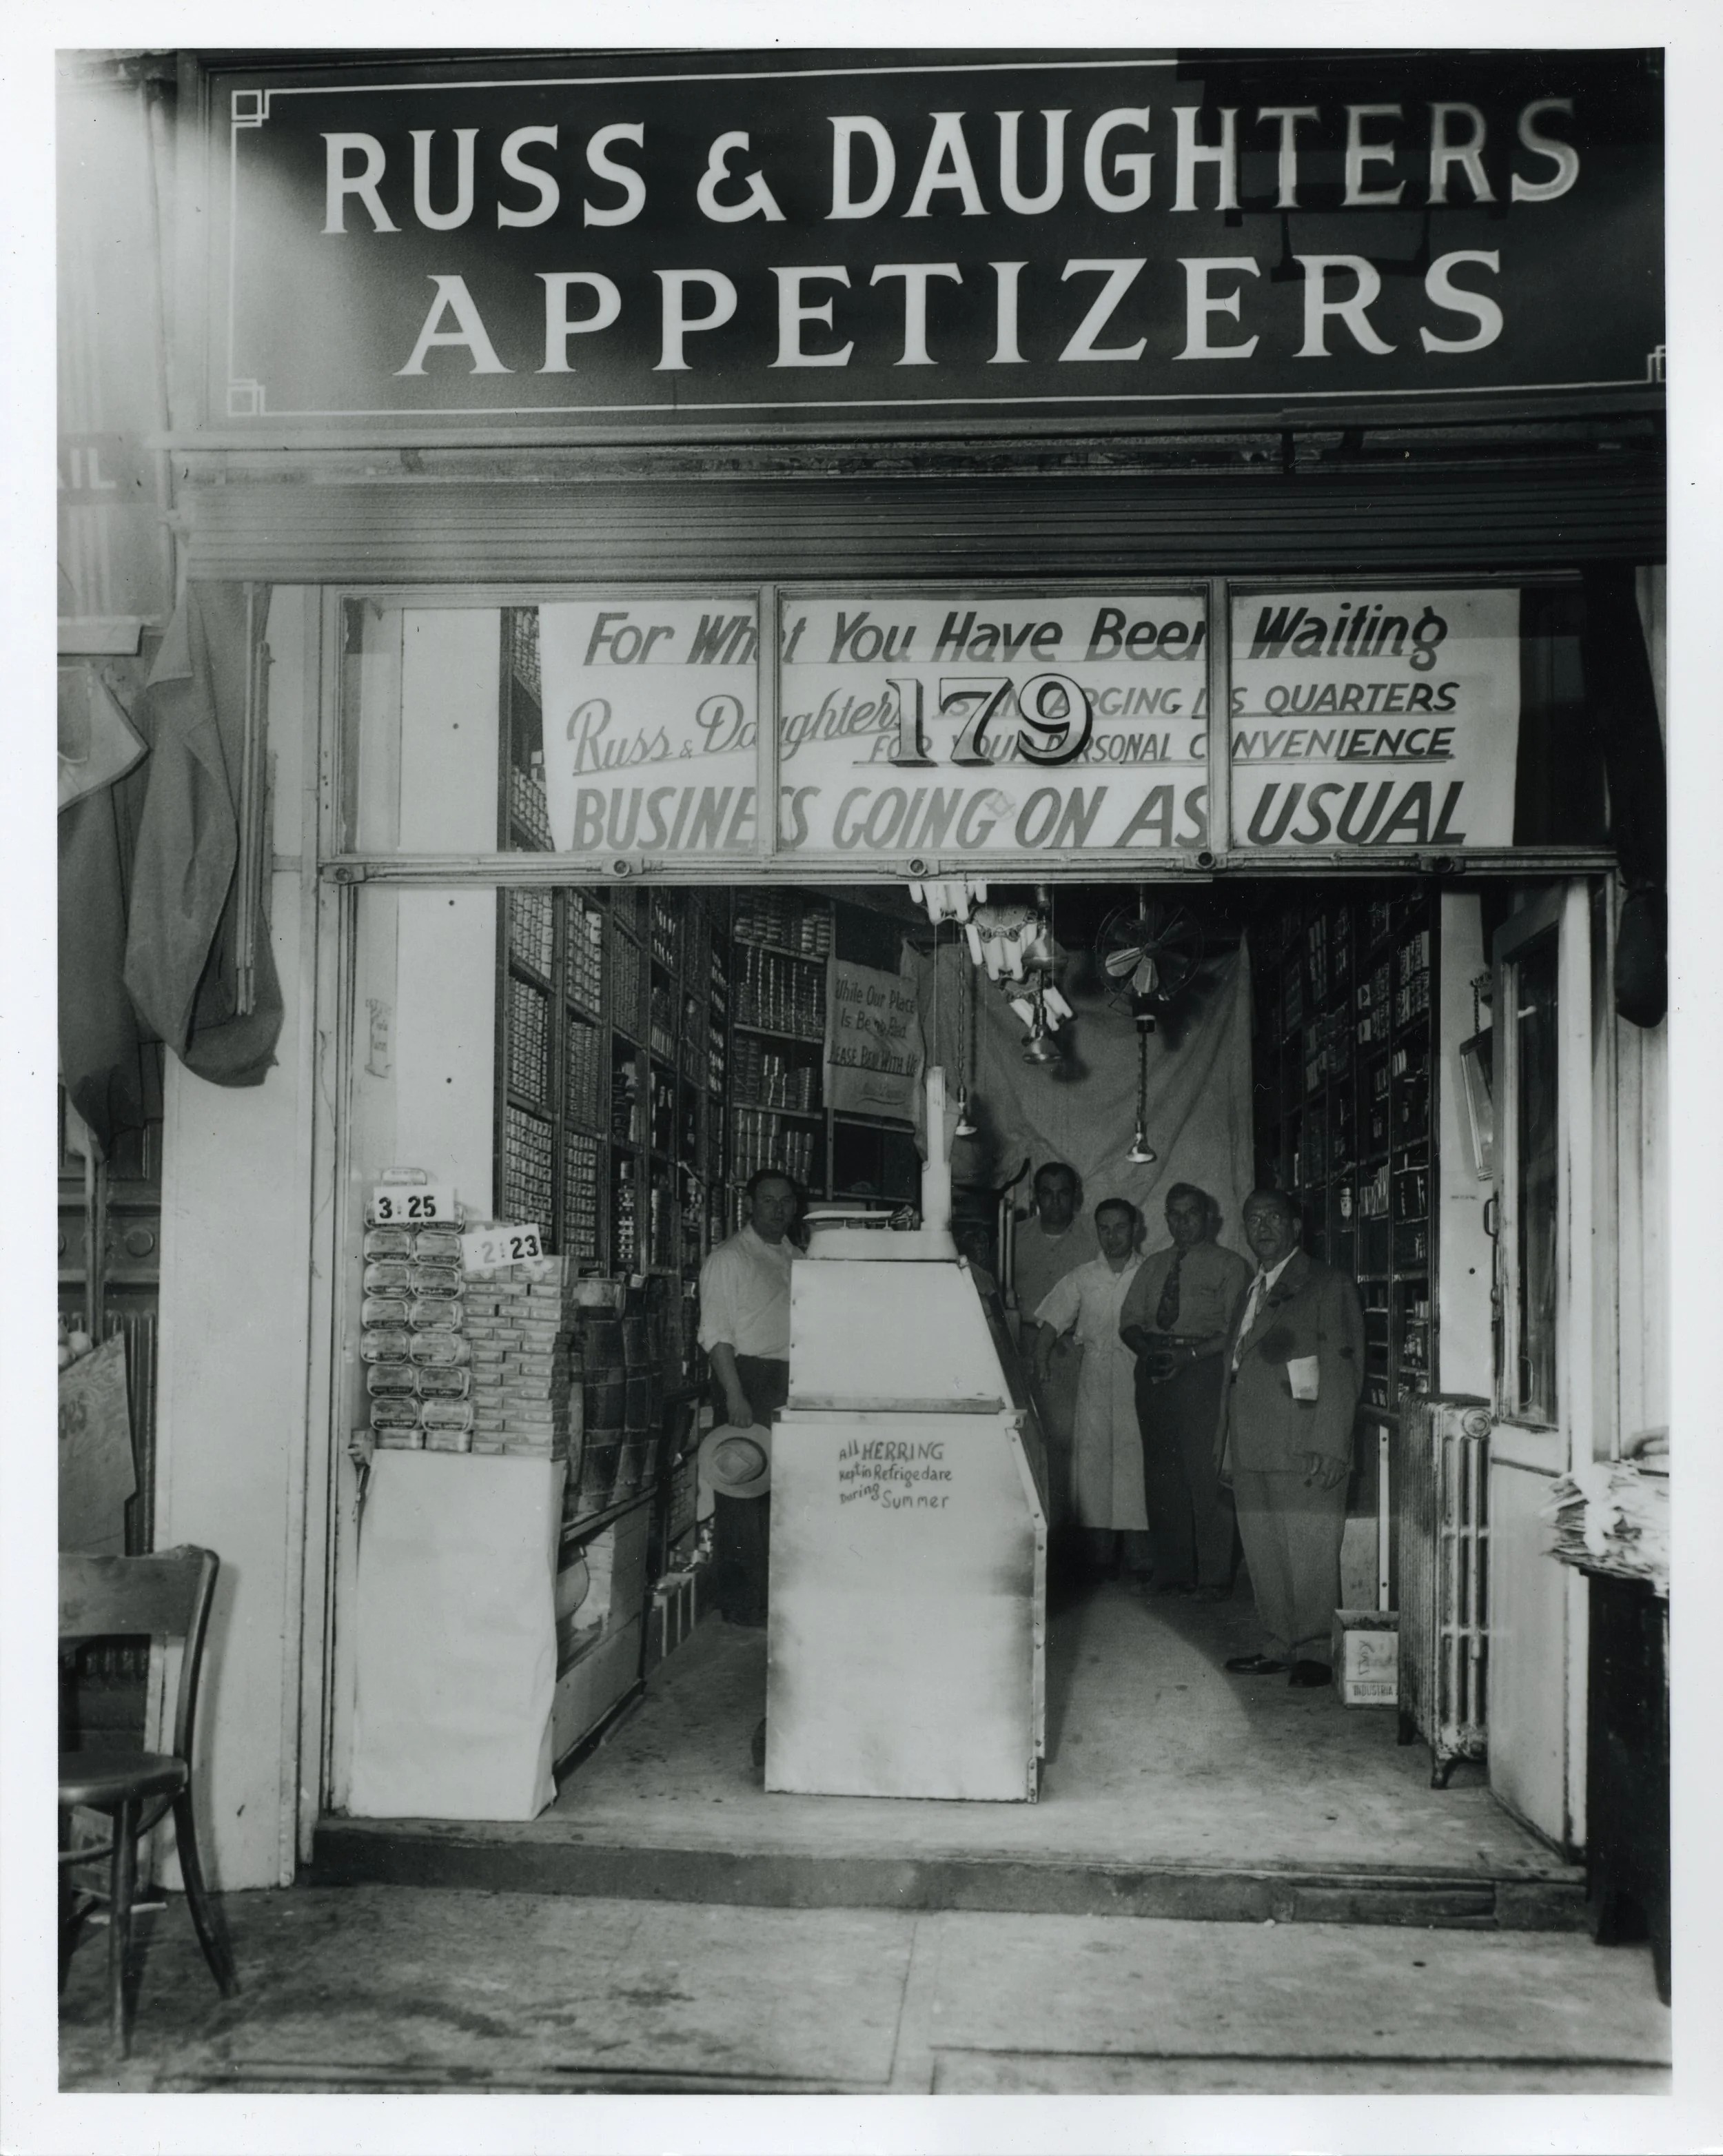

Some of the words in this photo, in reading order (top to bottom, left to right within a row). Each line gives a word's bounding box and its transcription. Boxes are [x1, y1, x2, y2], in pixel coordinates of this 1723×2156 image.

[319, 121, 648, 234] RUSS
[696, 130, 787, 223] &
[824, 97, 1580, 220] DAUGHTERS
[391, 249, 1505, 376] APPETIZERS
[58, 445, 117, 490] IL
[583, 611, 675, 666] For
[828, 610, 917, 663] You
[935, 611, 1063, 662] Have
[1247, 602, 1448, 671] Waiting
[1265, 681, 1460, 713] QUARTERS
[566, 696, 673, 773] Russ
[679, 738, 693, 756] &
[695, 687, 900, 762] Daghter
[885, 673, 1093, 767] 179
[1044, 733, 1172, 764] PRSONAL
[1189, 726, 1456, 760] CNVENIENCE
[832, 786, 1003, 848] GOING
[1014, 786, 1108, 848] ON
[1112, 783, 1209, 848] AS
[1247, 781, 1469, 847] USUAL
[866, 984, 886, 1008] Our
[841, 1007, 852, 1028] Is
[378, 1196, 393, 1219] 3
[407, 1194, 437, 1218] 25
[482, 1241, 496, 1264] 2
[509, 1234, 539, 1259] 23
[862, 1441, 944, 1461] HERRING
[862, 1464, 872, 1478] in
[881, 1489, 949, 1509] Summer
